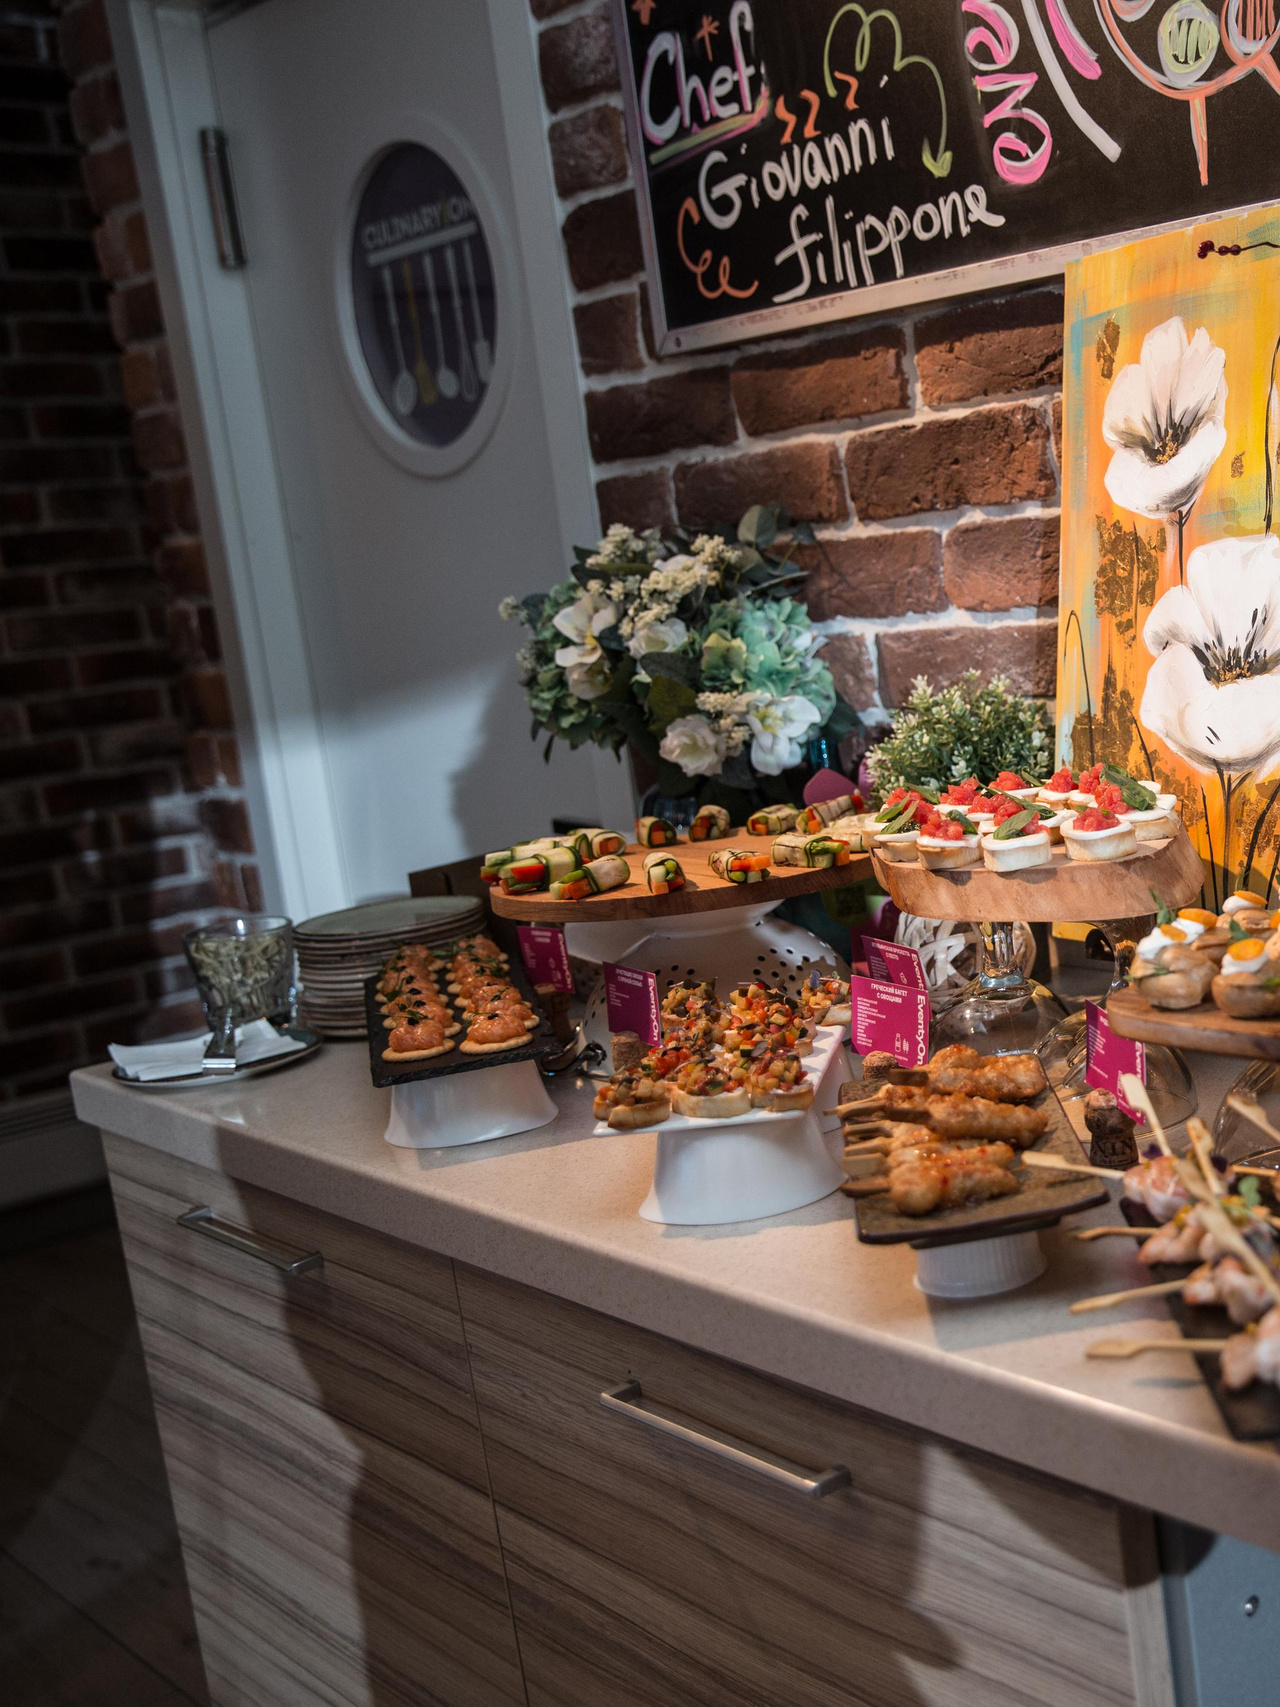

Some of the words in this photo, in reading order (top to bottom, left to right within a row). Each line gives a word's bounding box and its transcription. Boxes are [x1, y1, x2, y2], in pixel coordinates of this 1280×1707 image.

[640, 0, 757, 146] Chef
[698, 74, 896, 230] Giovanni
[772, 183, 1006, 304] filippone
[647, 978, 660, 1041] EventyOn
[916, 994, 927, 1066] EventyOn
